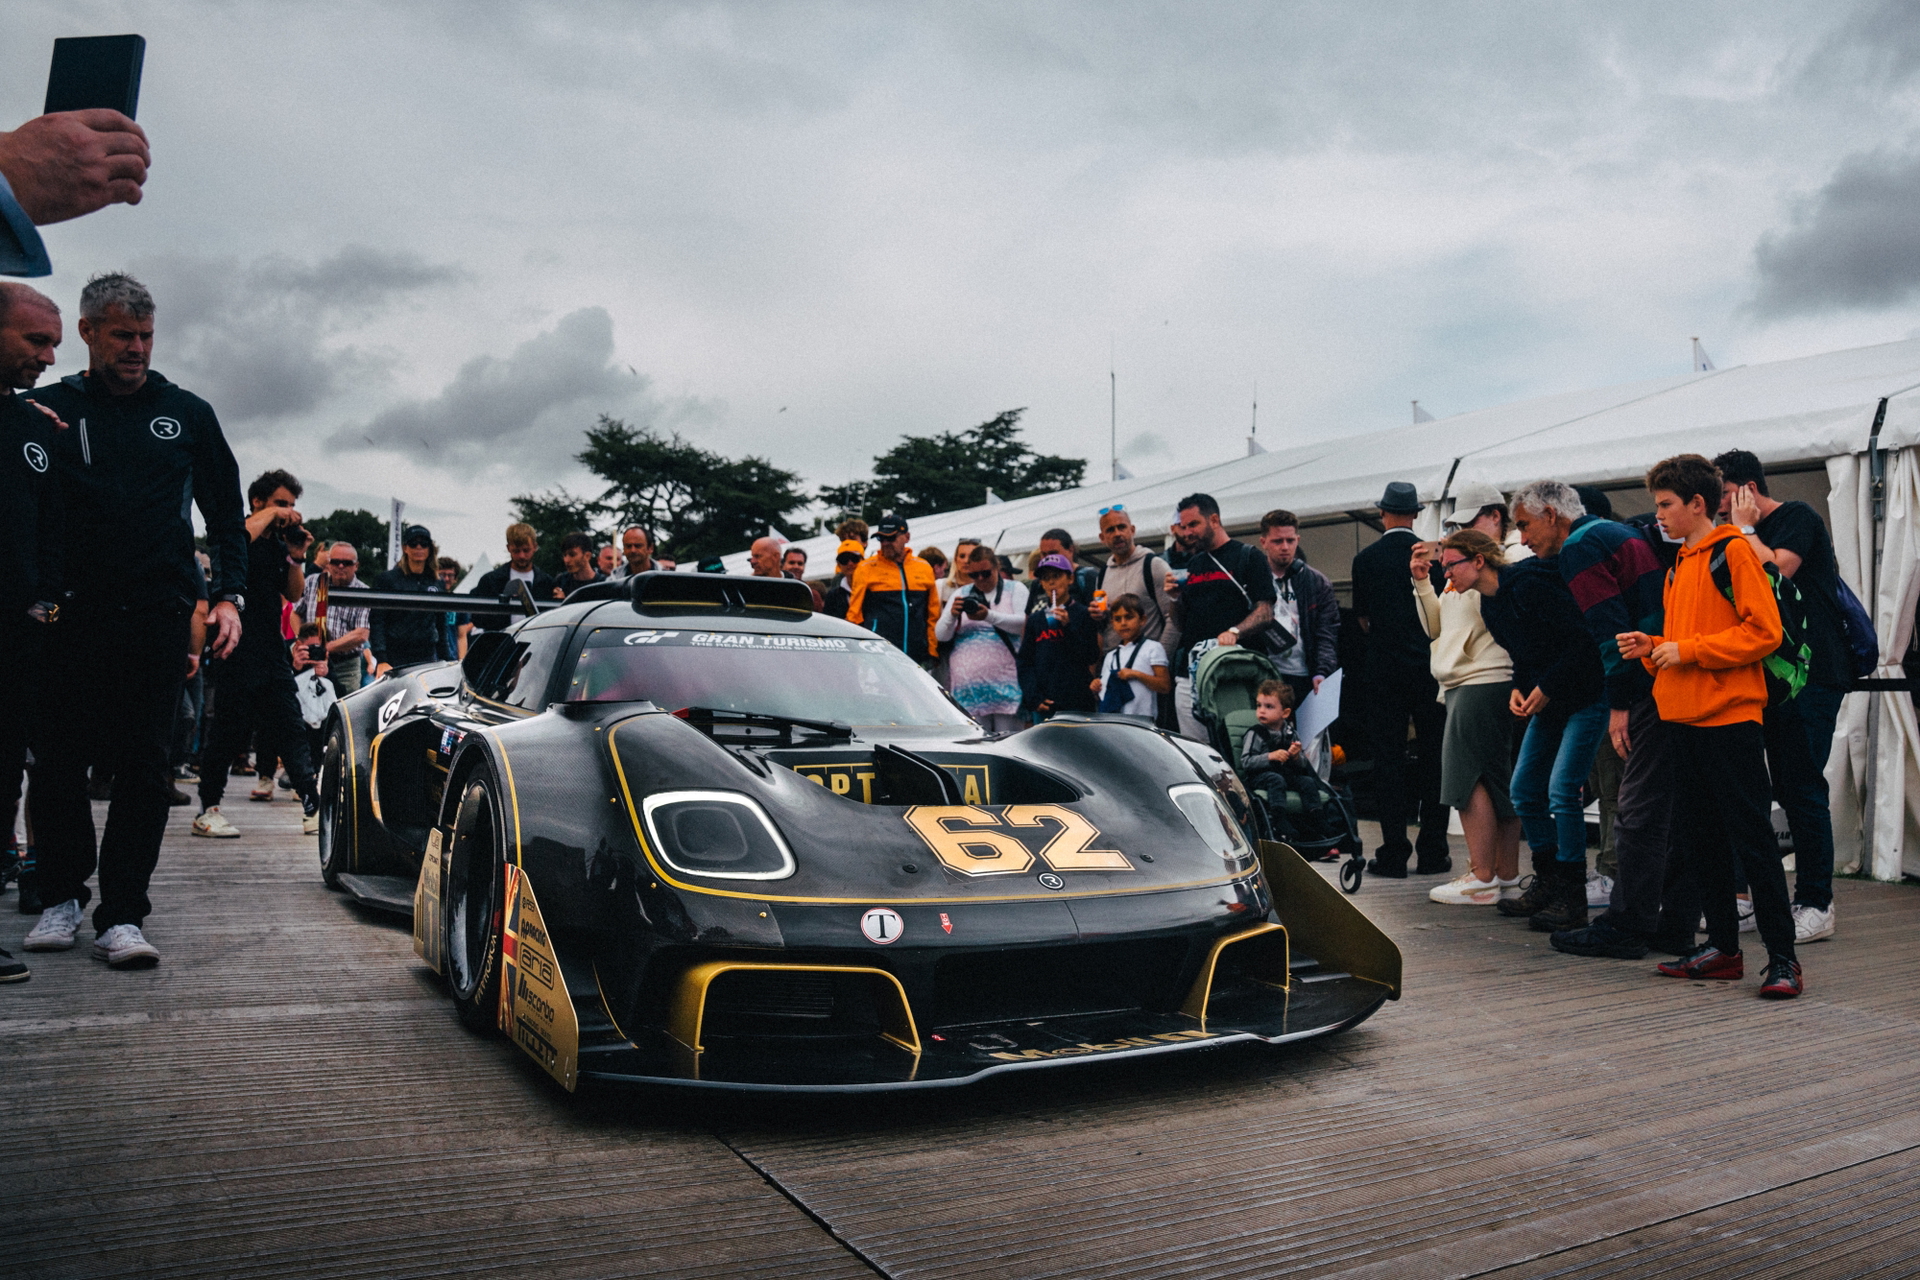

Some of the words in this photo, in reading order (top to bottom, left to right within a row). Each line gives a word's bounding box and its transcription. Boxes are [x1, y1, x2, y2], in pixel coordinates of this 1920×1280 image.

[691, 633, 754, 645] GRAN
[761, 637, 847, 648] TURISMO
[903, 803, 1136, 877] 62
[867, 914, 897, 939] T
[521, 948, 553, 990] aria
